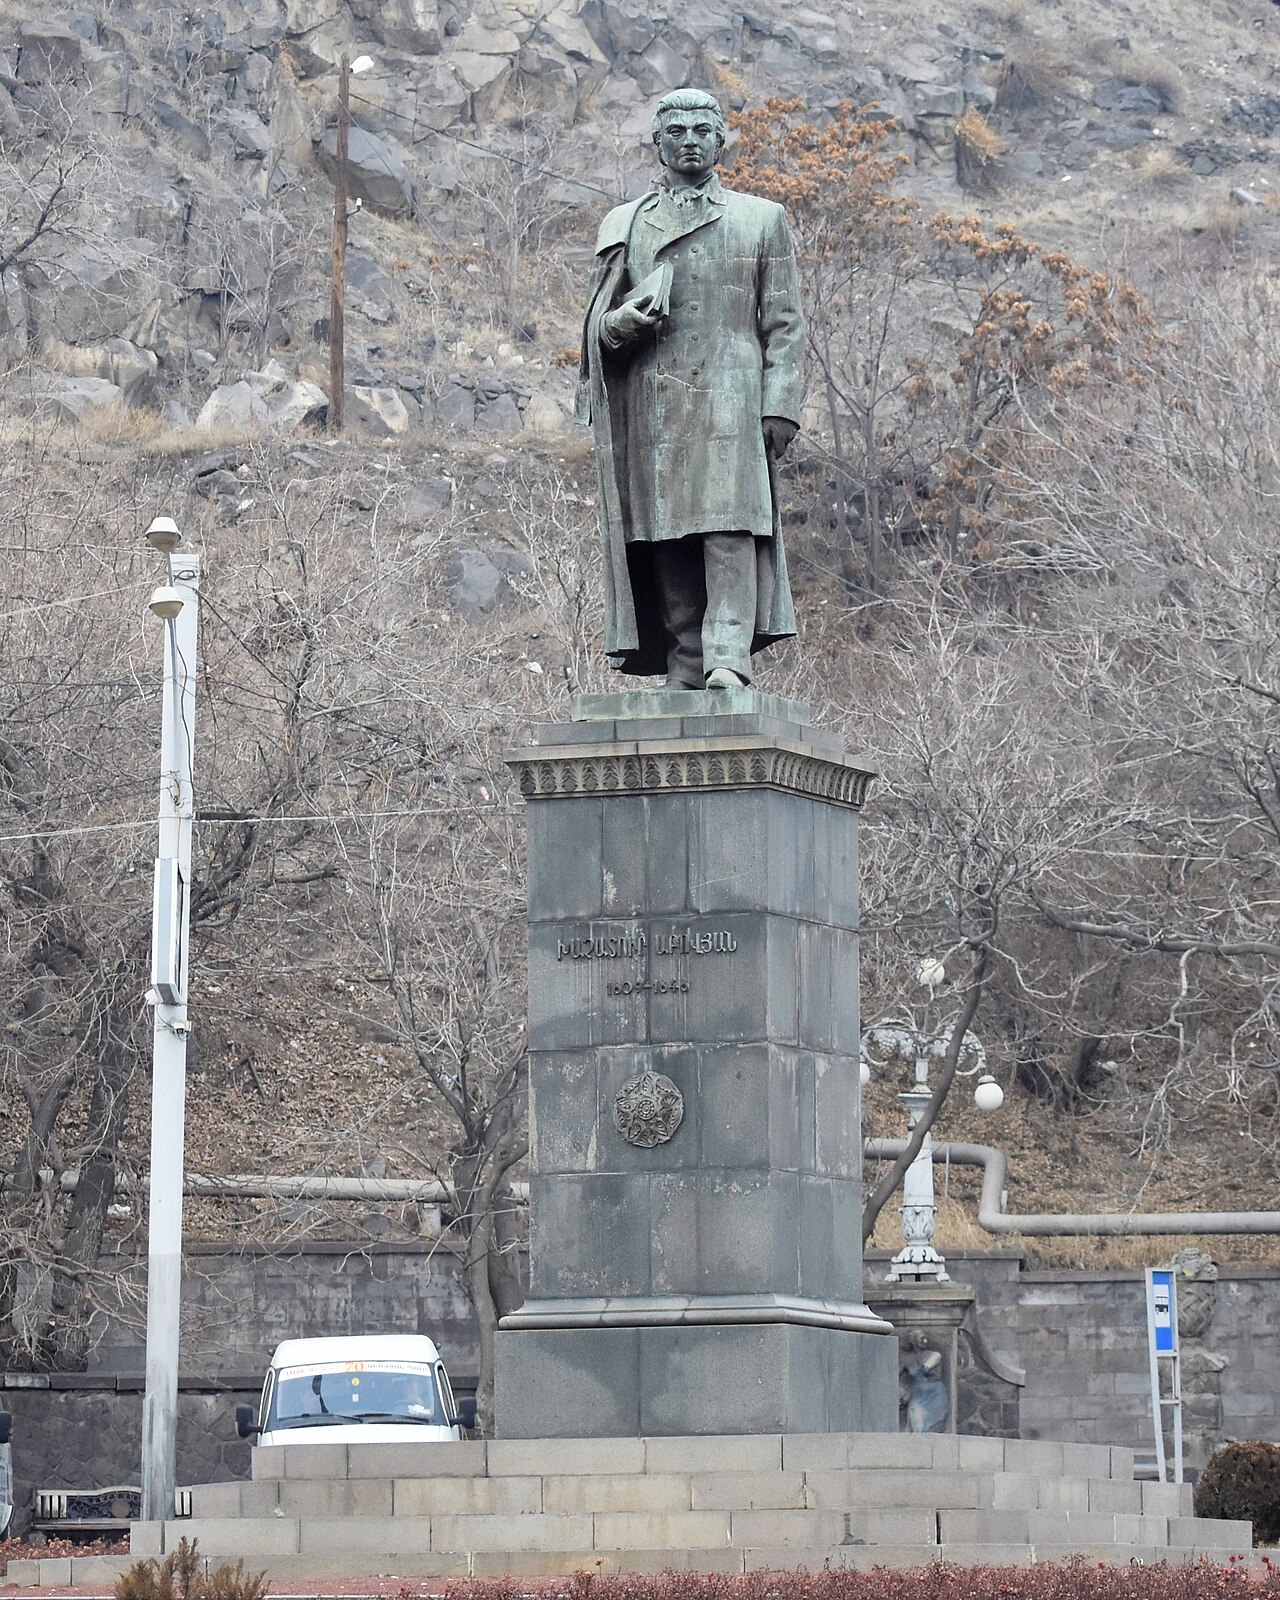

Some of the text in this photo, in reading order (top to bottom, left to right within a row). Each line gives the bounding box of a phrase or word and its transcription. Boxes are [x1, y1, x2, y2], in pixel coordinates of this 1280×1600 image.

[557, 931, 738, 961] ԽԱՉԱՏՈՒՐ ԱԲՈՎՅԱՆ
[346, 1361, 364, 1372] 70
